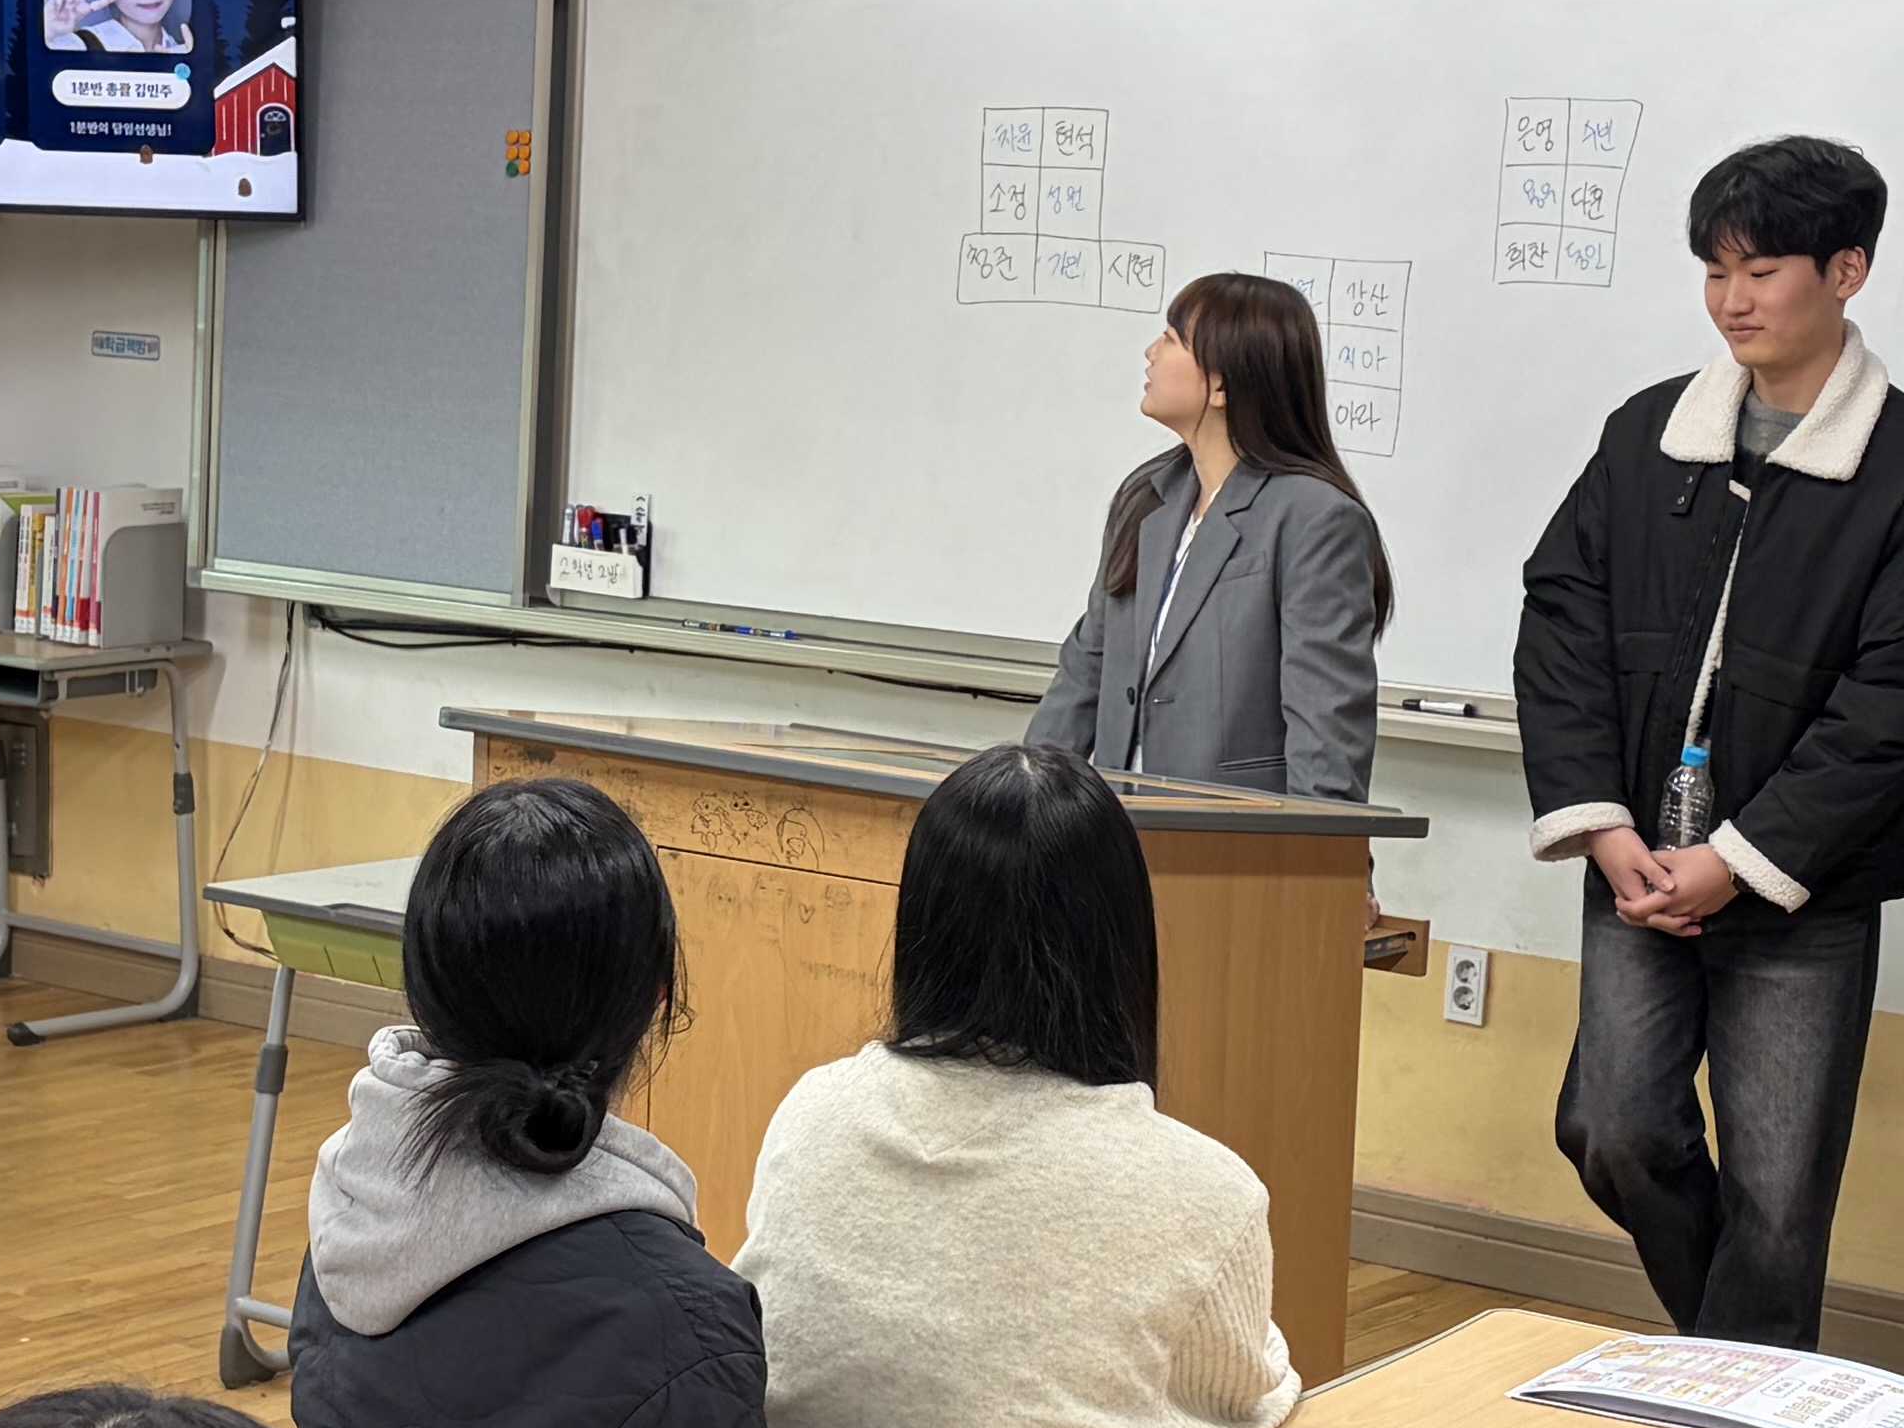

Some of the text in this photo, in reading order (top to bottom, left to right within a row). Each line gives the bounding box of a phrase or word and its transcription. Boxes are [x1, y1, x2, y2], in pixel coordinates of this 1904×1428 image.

[1055, 120, 1095, 160] 현석
[1517, 116, 1554, 152] 은영
[989, 183, 1026, 220] 소정
[1108, 251, 1155, 287] 시현
[1346, 279, 1389, 316] 강산
[1335, 400, 1381, 432] 아라
